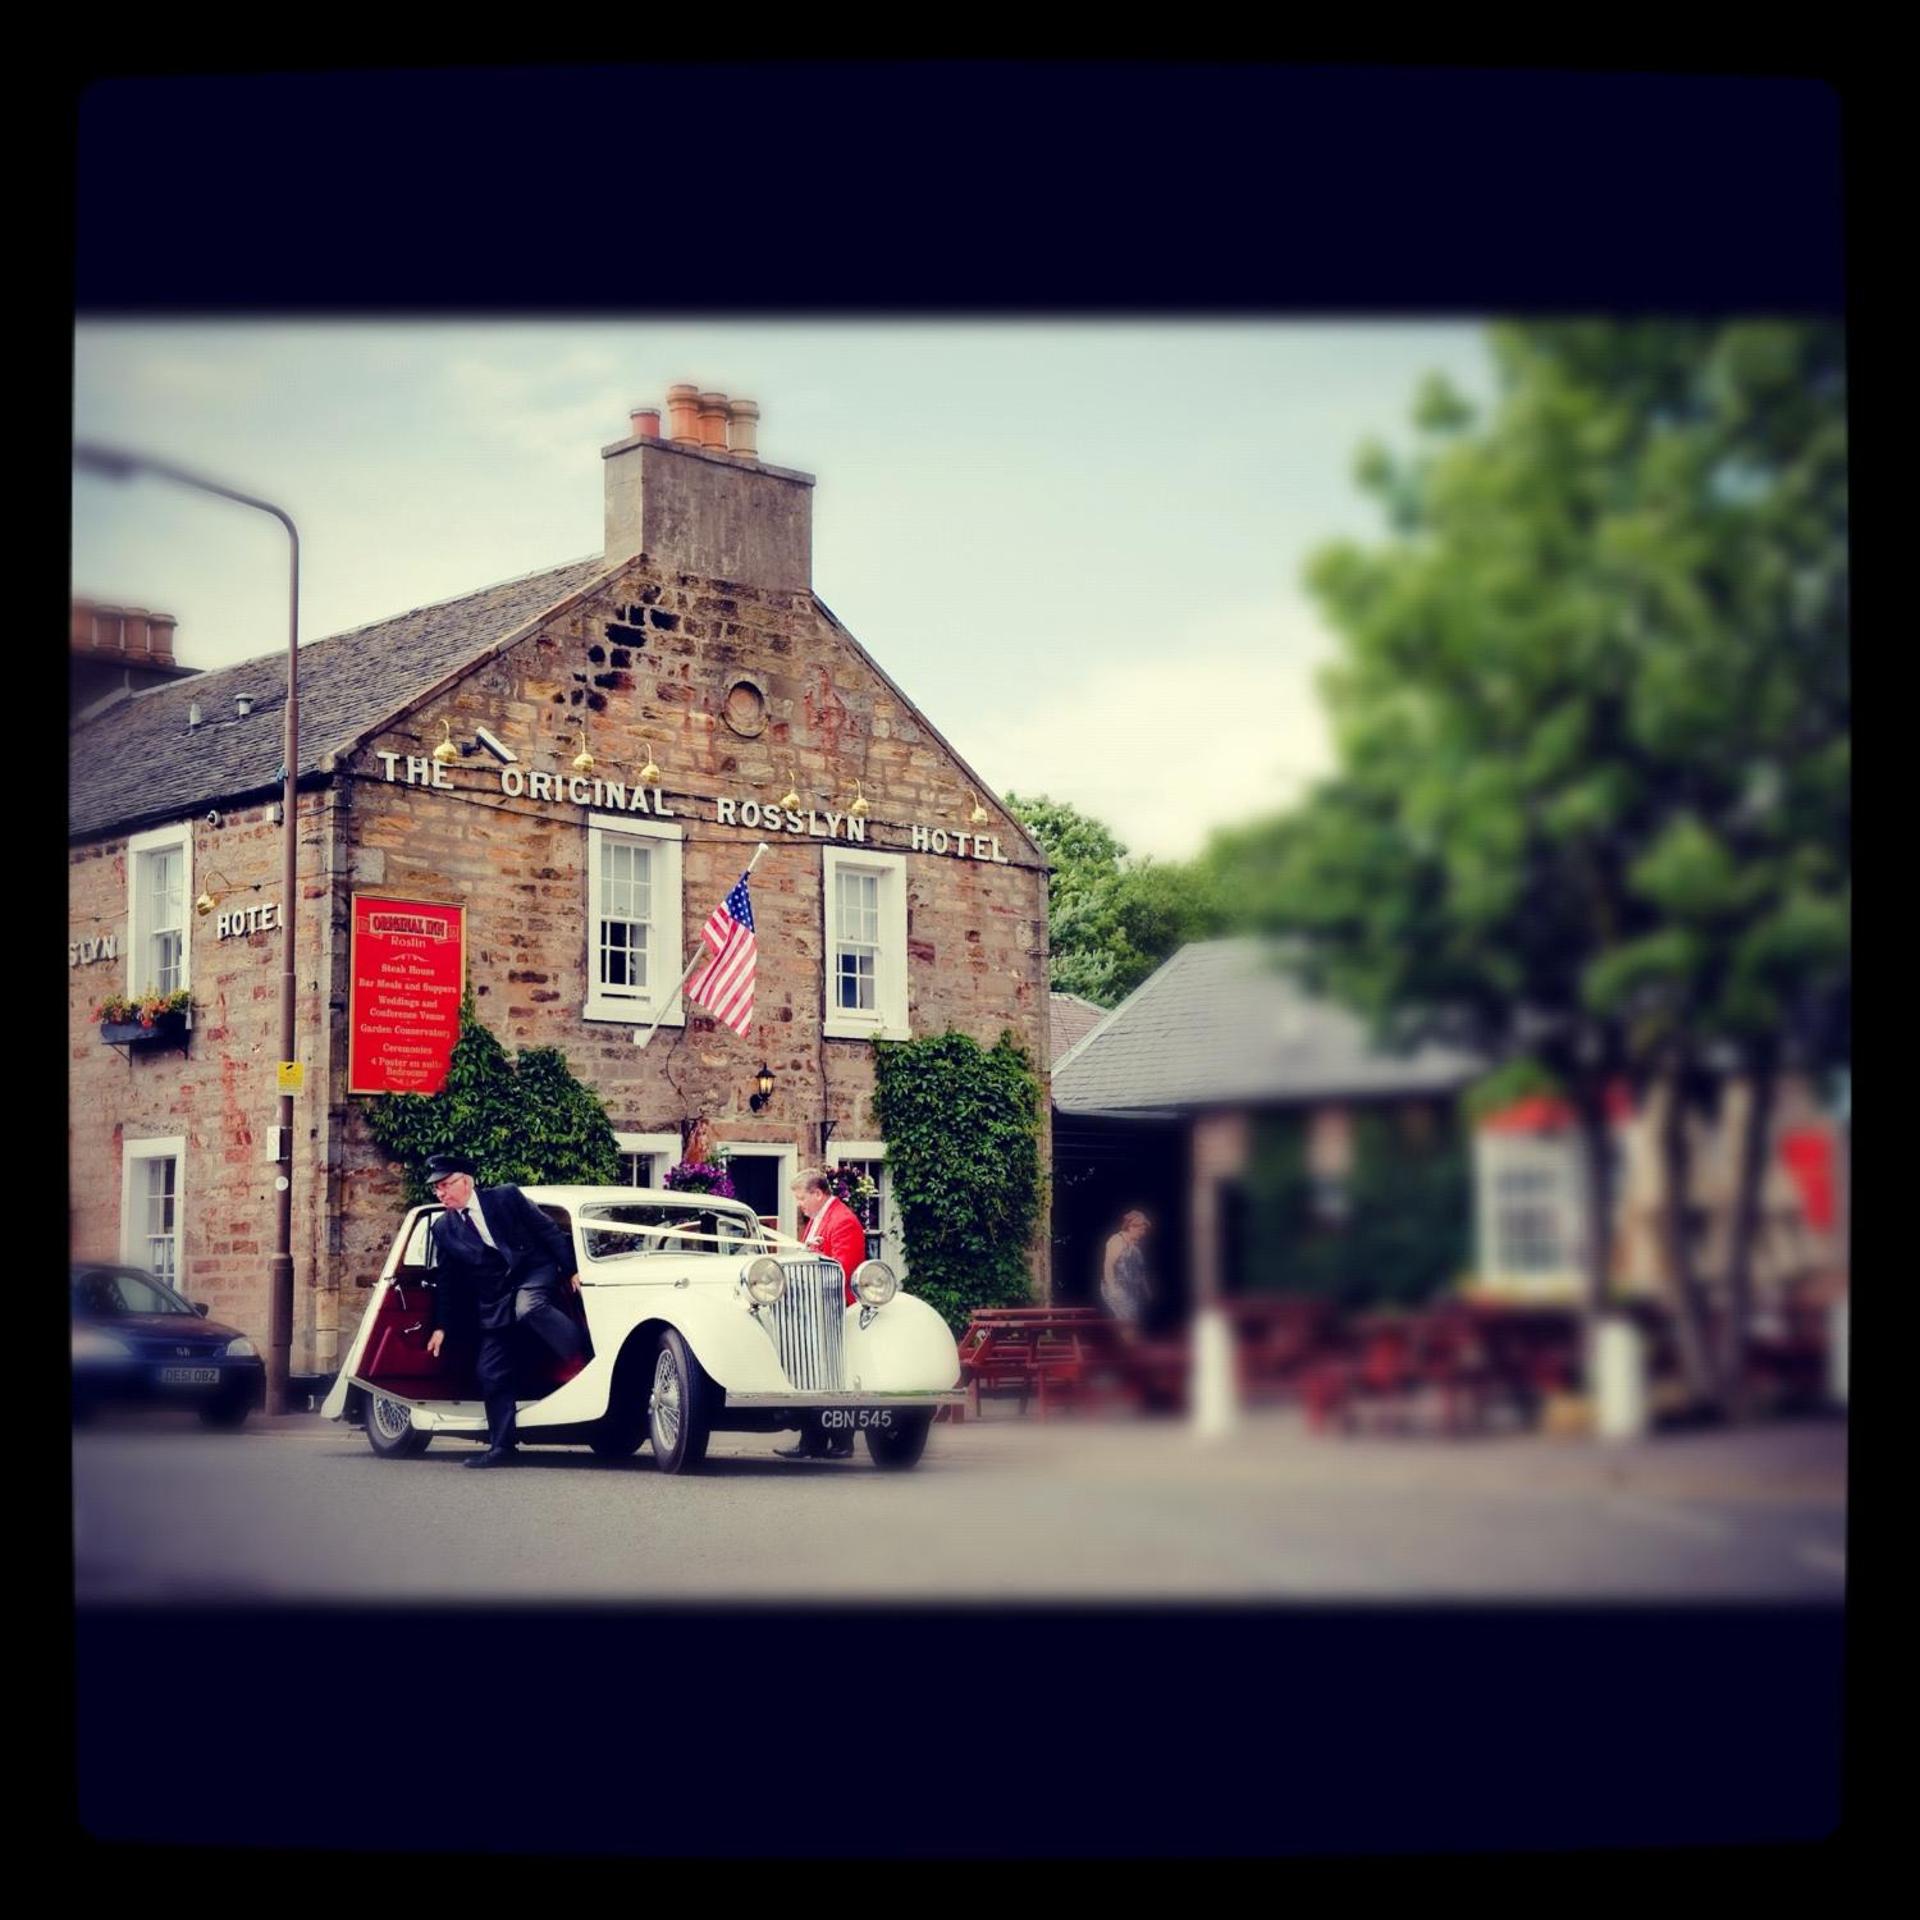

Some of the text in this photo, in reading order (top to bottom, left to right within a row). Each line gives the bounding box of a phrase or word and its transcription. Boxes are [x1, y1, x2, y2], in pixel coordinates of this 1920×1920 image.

[377, 751, 1008, 864] THE ORIGINAL ROSSLYN HOTEL
[381, 963, 435, 976] Steak House
[359, 977, 457, 995] Bar Meals and Suppers
[378, 995, 438, 1009] Weddings and
[369, 1007, 446, 1021] Conference Venue
[360, 1023, 450, 1039] Garden Conservatory
[382, 1042, 432, 1055] Ceremonies
[379, 1056, 408, 1067] Poster
[386, 1067, 428, 1078] Bedrooms
[821, 1410, 892, 1428] CBN 545
